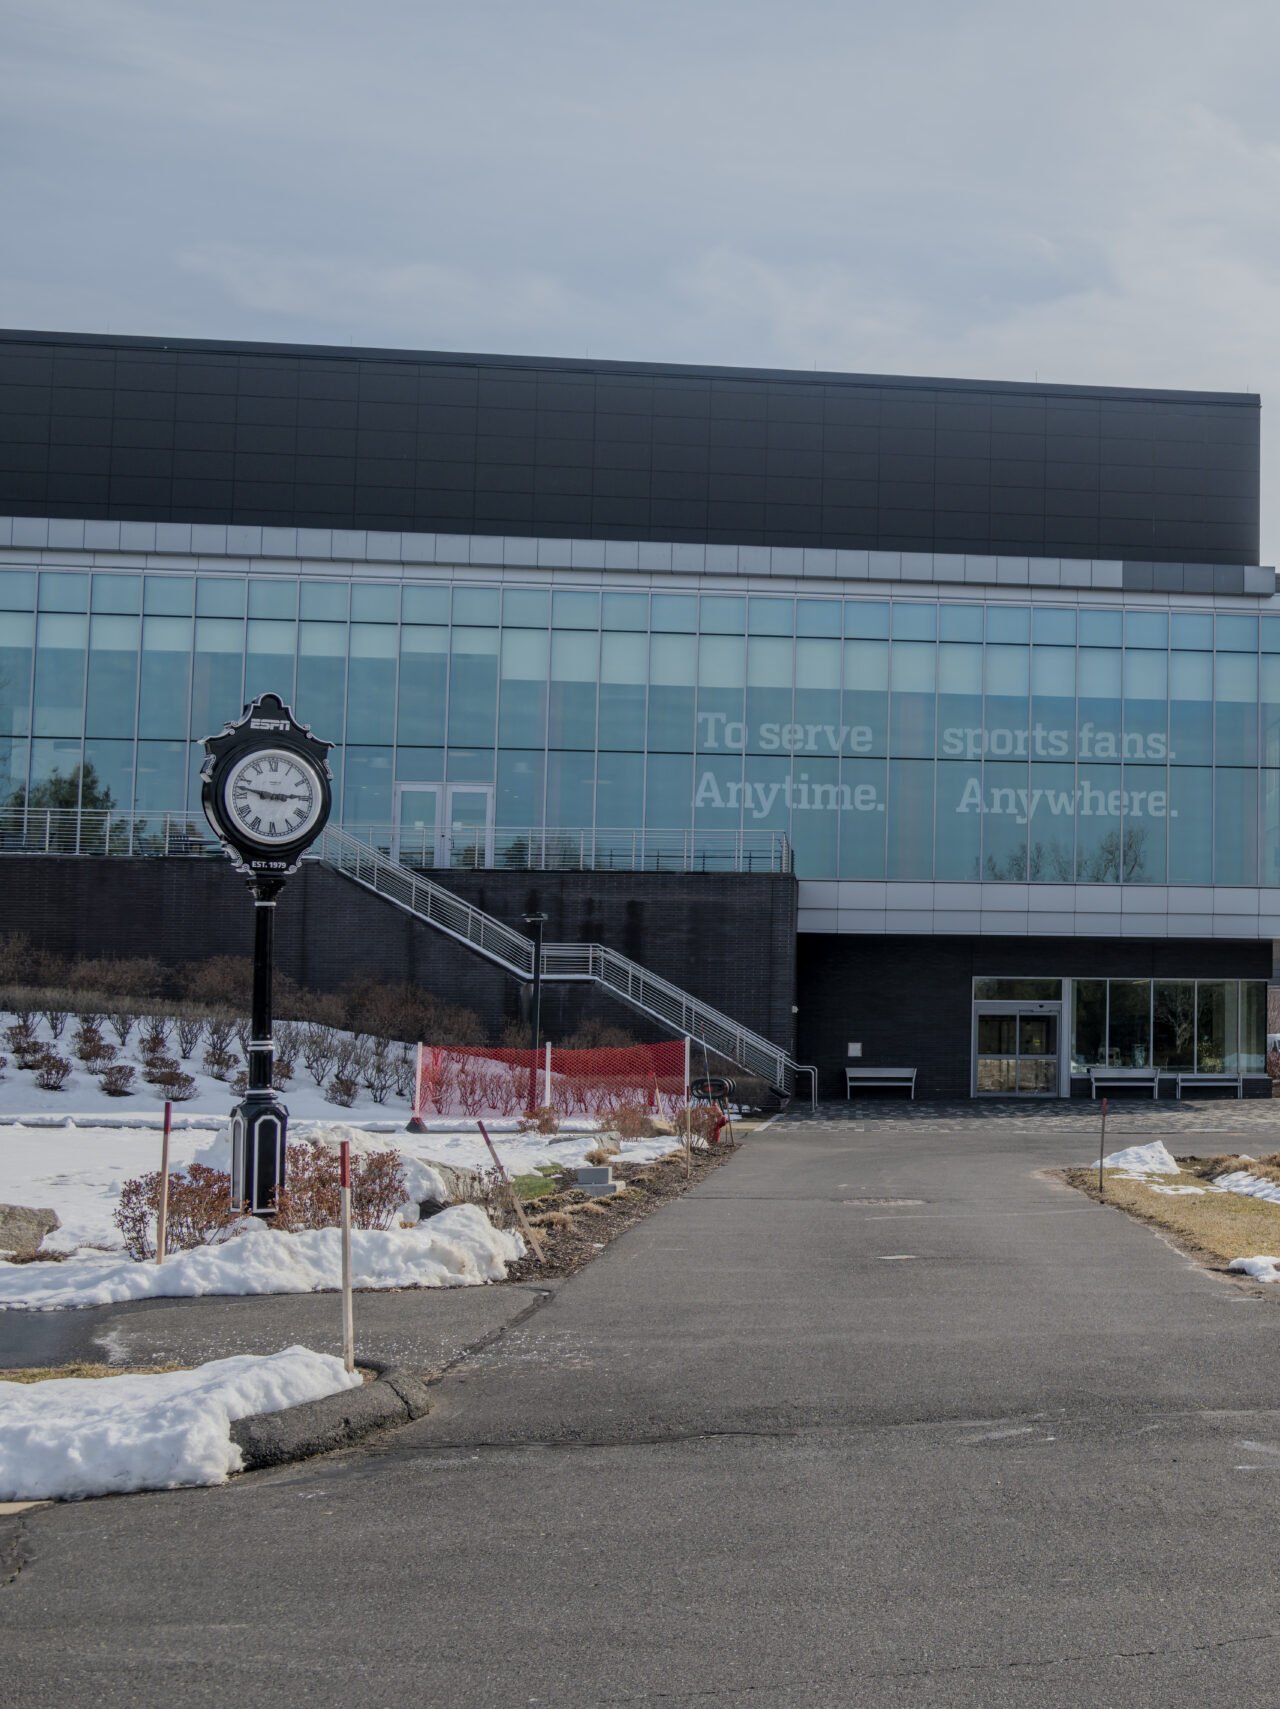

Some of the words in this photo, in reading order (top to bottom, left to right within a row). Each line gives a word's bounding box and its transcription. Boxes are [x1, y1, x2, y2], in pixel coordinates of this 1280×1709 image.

[251, 718, 290, 730] ESPN
[698, 712, 748, 749] To
[759, 723, 873, 752] serve
[943, 723, 1068, 760] sports
[1079, 722, 1176, 759] fans.
[252, 763, 263, 776] XI
[268, 761, 278, 772] XII
[236, 791, 247, 800] IX
[691, 772, 885, 819] Anytime.
[956, 778, 1178, 824] Anywhere.
[269, 821, 276, 833] VI
[269, 861, 287, 869] 1979
